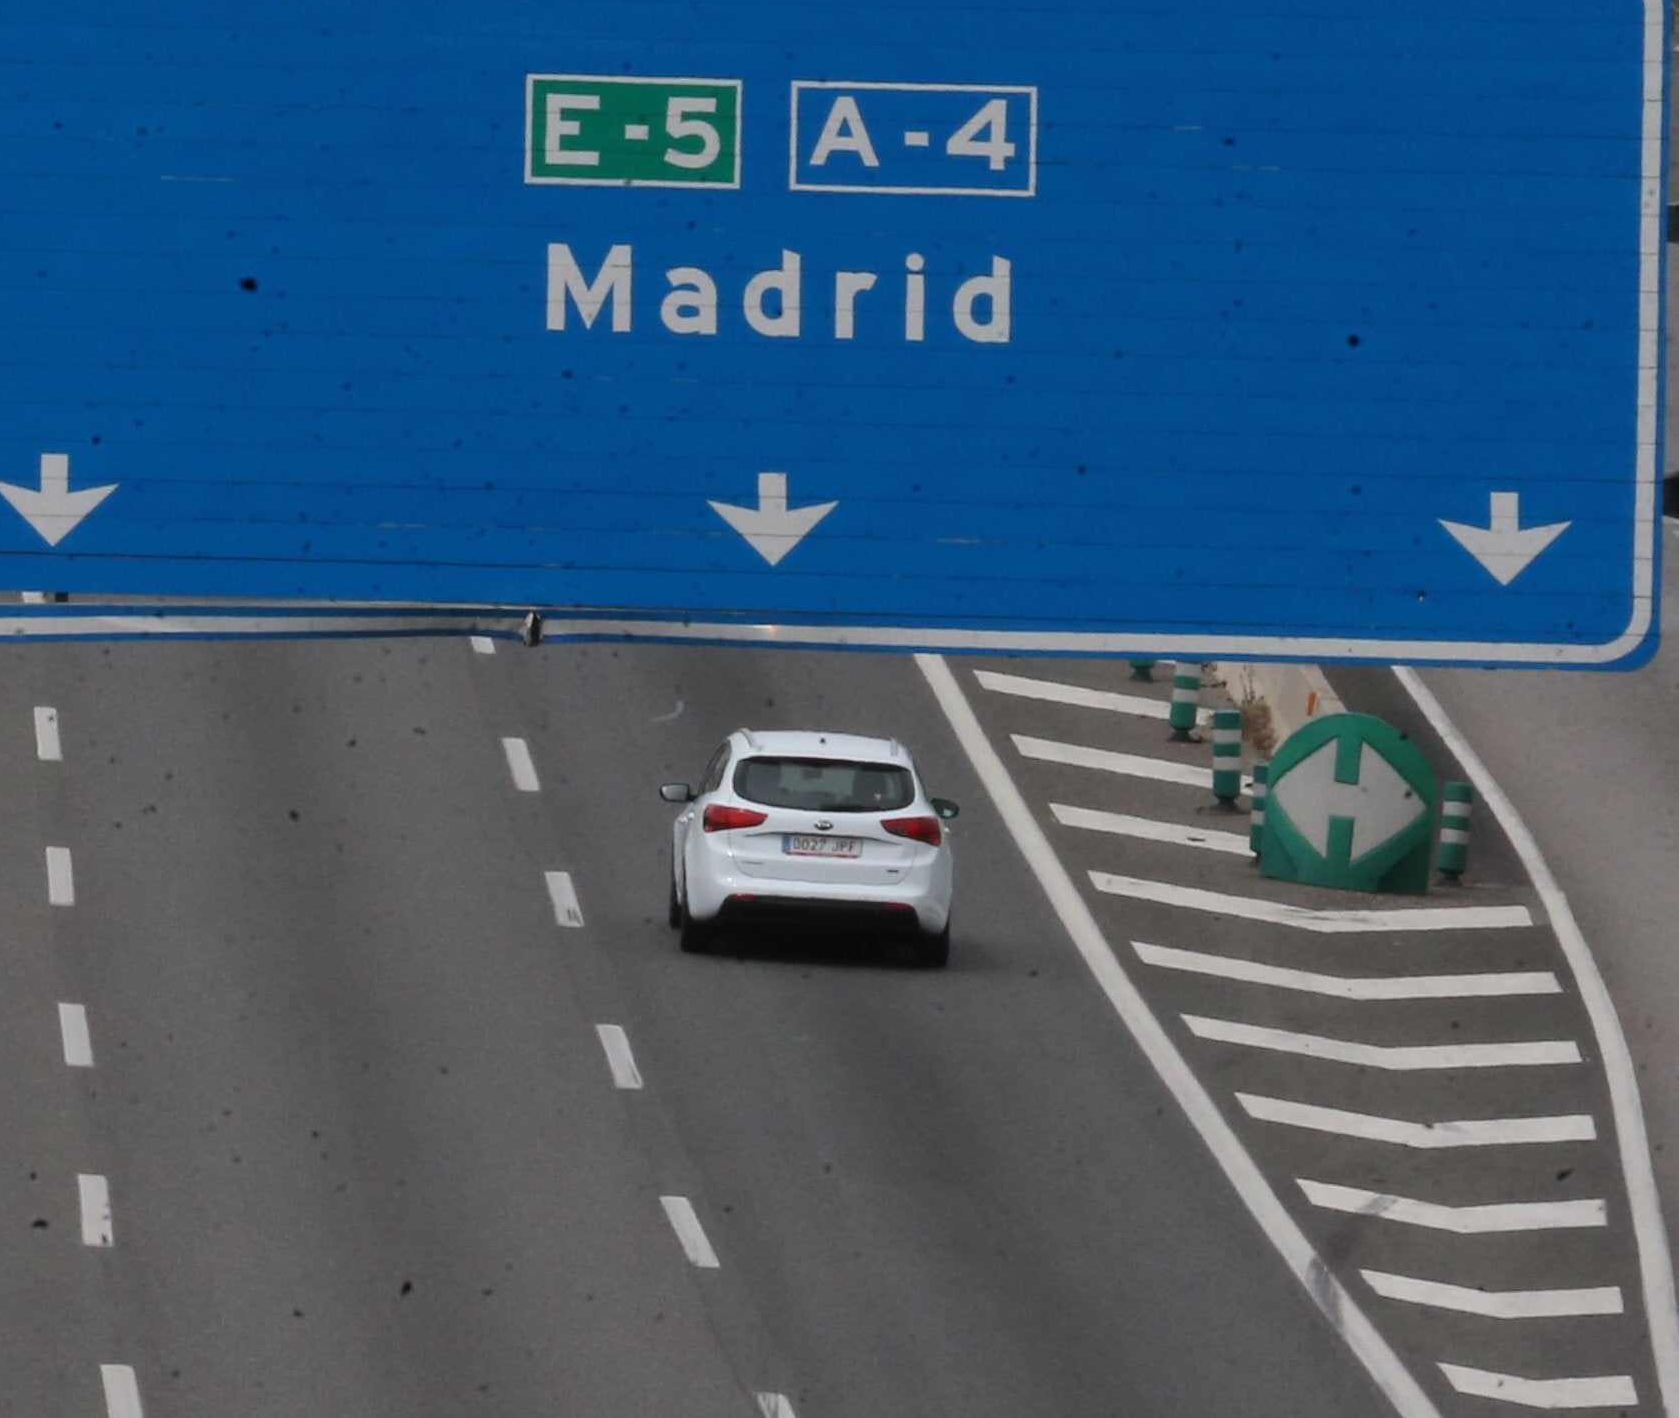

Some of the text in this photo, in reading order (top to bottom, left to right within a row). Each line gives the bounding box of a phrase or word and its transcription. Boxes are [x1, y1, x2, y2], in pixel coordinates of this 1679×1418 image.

[544, 92, 1016, 171] E-5 A-4
[546, 242, 1012, 344] Madrid
[792, 837, 857, 853] 0027 JPF
